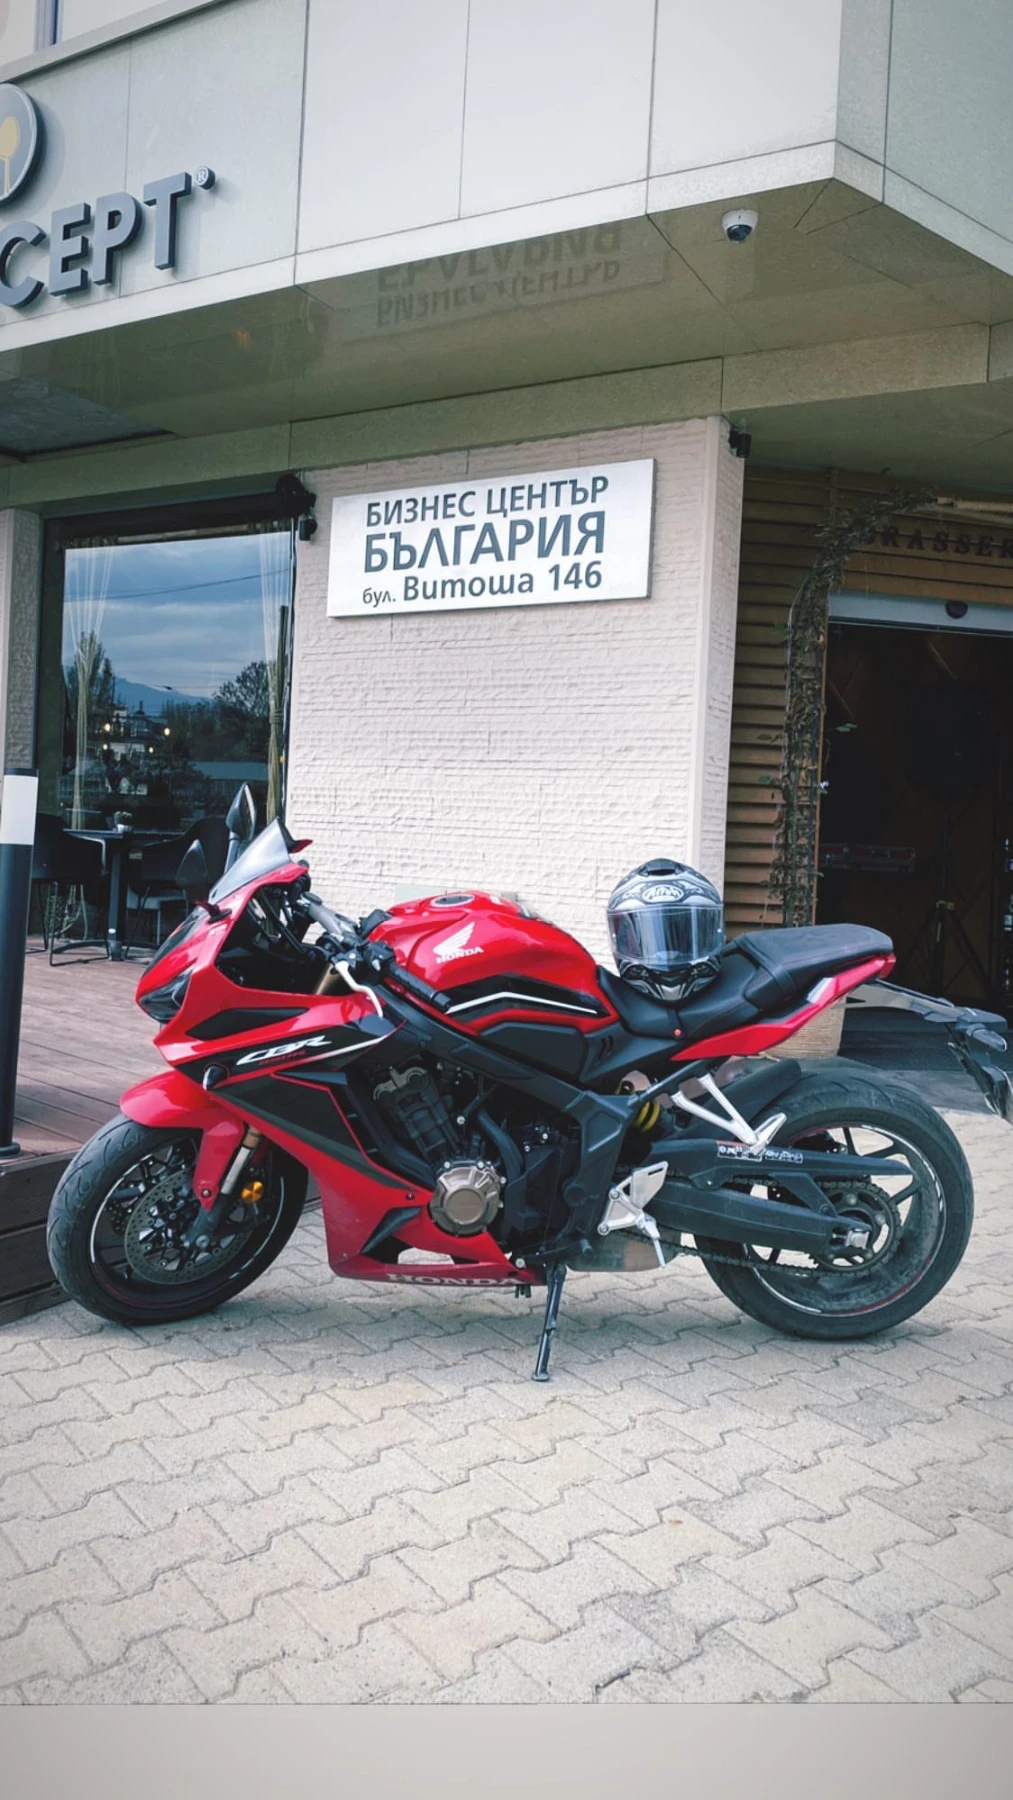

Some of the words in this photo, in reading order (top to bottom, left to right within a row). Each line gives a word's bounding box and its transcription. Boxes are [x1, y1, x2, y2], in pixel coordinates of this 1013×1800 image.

[366, 490, 476, 527] БИЗНЕС
[486, 475, 609, 518] ЦЕНТЪР
[364, 510, 606, 573] БЪЛГАРИЯ
[362, 588, 396, 608] бул.
[403, 572, 534, 601] Витоша
[548, 560, 602, 591] 146
[436, 946, 484, 965] HONDA
[236, 1034, 332, 1066] CBR
[386, 1272, 525, 1287] HONDA
